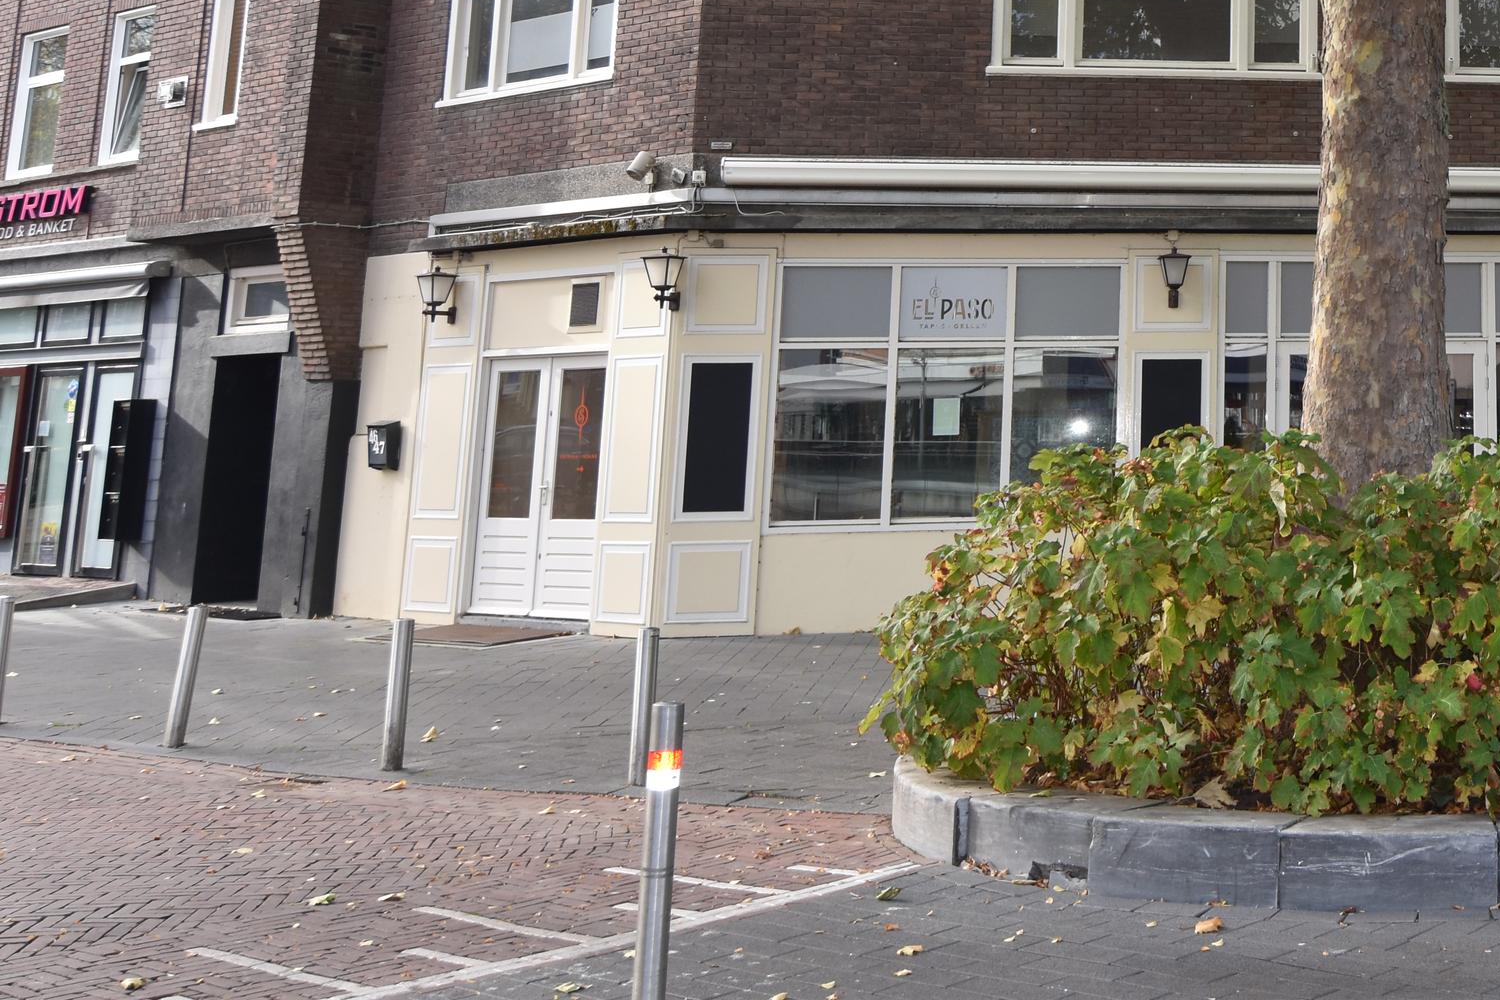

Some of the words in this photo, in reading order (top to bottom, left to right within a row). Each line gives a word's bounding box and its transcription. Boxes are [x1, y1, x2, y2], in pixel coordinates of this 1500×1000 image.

[0, 184, 86, 222] TROM
[16, 223, 25, 238] &
[27, 217, 76, 237] BANKET
[912, 298, 935, 320] EL
[940, 298, 994, 320] PASO
[368, 429, 379, 444] 46
[372, 440, 386, 455] 47
